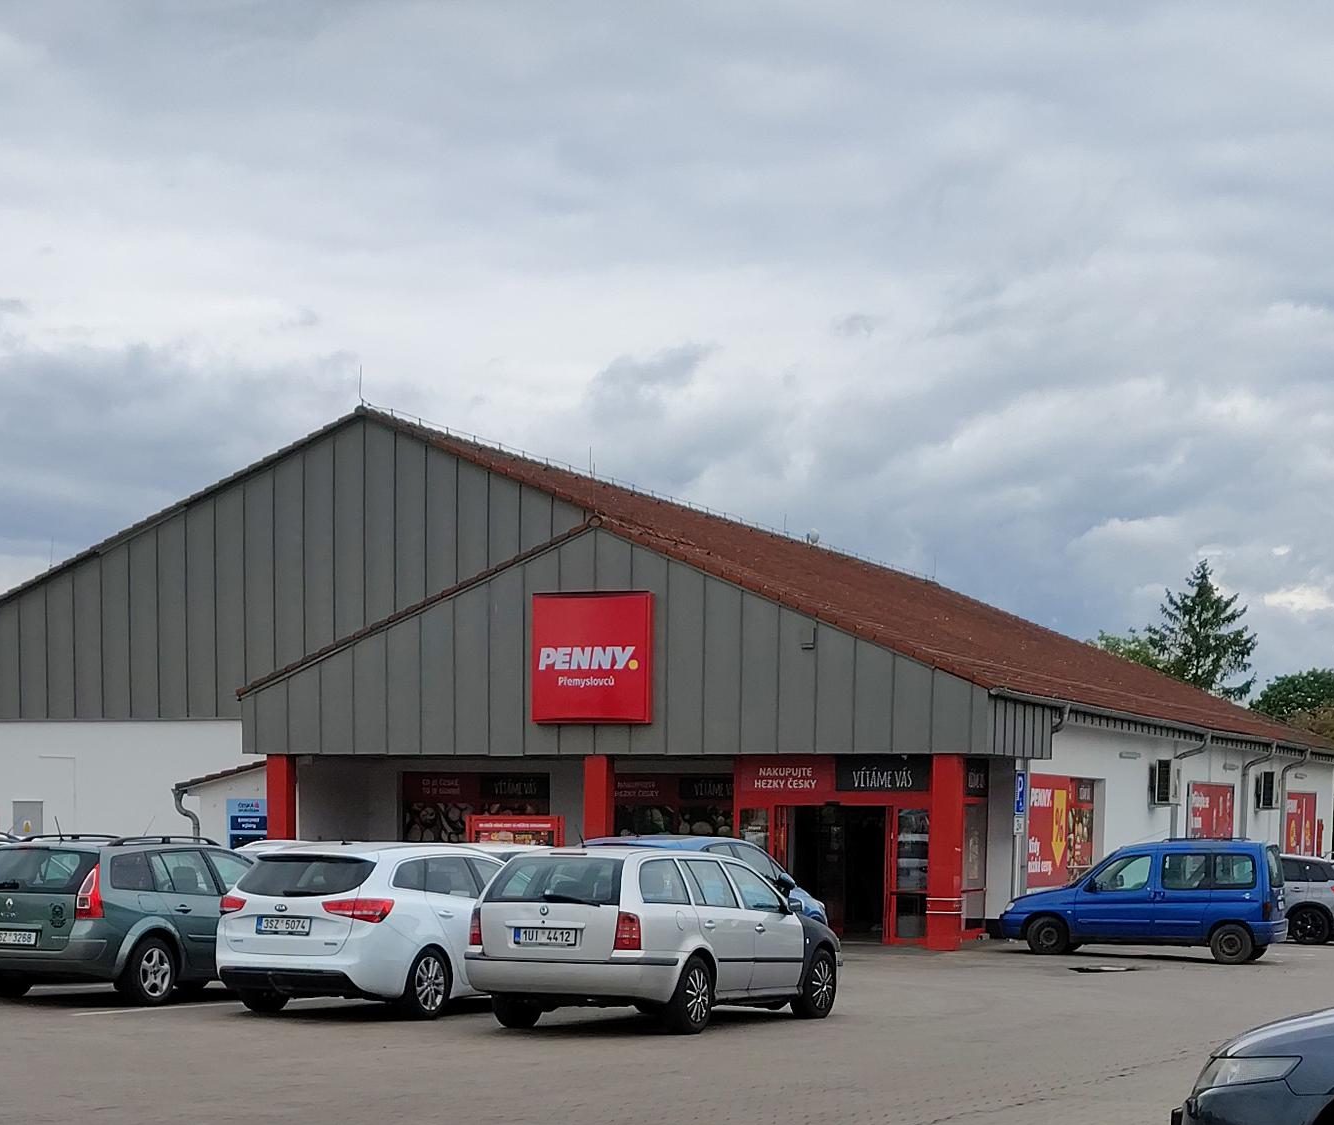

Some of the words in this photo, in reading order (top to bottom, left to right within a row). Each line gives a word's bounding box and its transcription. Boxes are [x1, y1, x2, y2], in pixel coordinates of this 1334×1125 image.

[538, 645, 639, 671] PENNY.
[557, 675, 615, 689] Přemyslovců
[759, 767, 813, 778] NAKUPUJTE
[852, 766, 892, 789] VÍTÁME
[894, 766, 913, 789] VÁS
[754, 779, 785, 789] HEZKY
[786, 777, 818, 789] ČESKY
[263, 919, 280, 930] 3SZ
[285, 920, 306, 931] 5074
[547, 930, 571, 942] 4412
